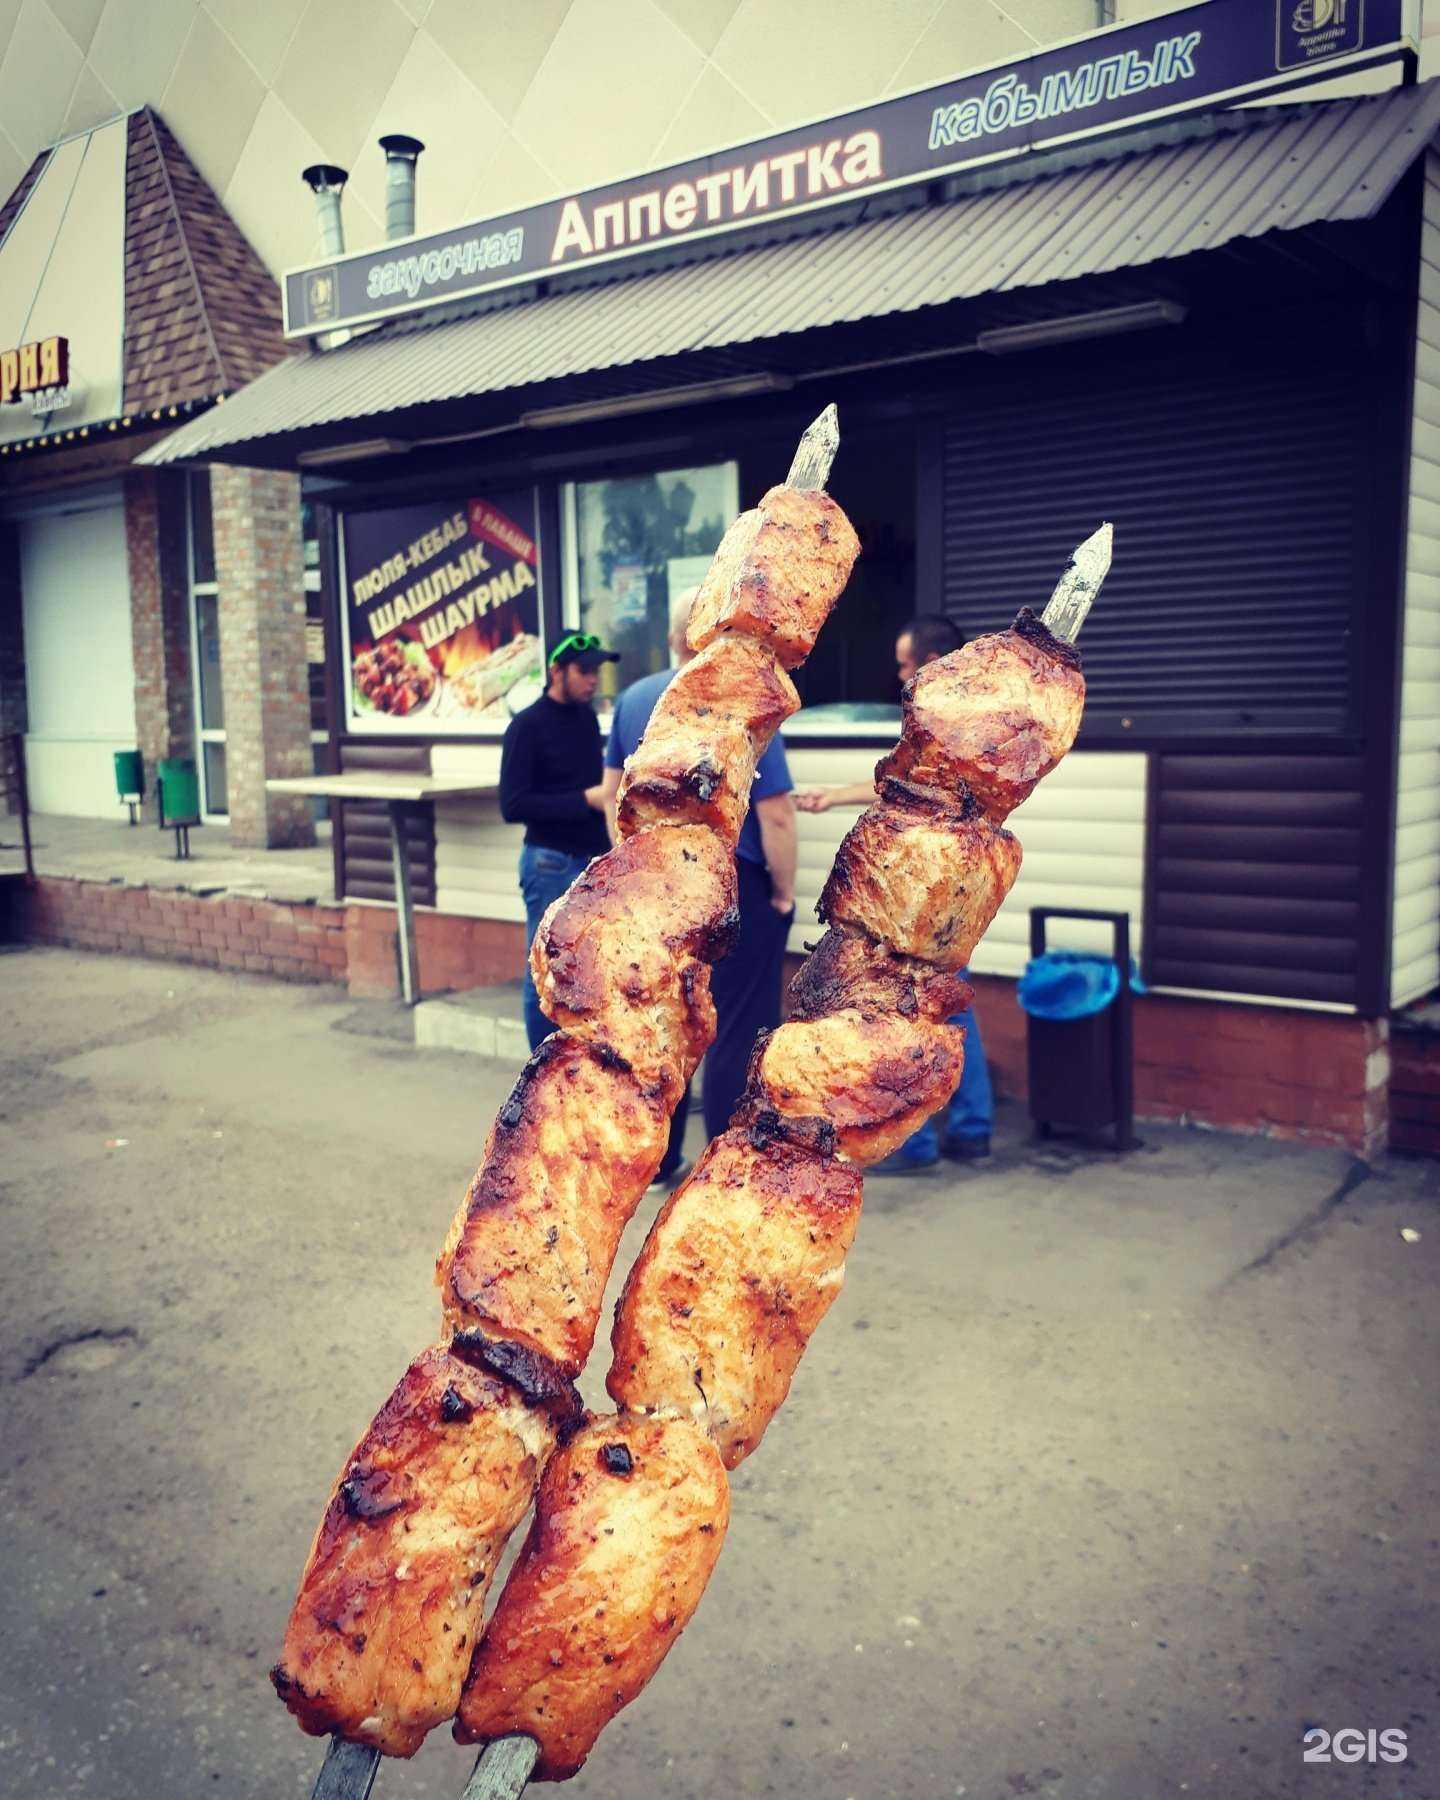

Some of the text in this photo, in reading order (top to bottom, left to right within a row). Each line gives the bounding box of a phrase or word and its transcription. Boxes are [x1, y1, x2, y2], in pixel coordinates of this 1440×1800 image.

[367, 31, 1201, 298] закусочная Аппетитка кабымлык
[352, 512, 468, 606] ЛЮЛЯ-КЕБАБ
[368, 542, 491, 640] ШАШЛЫК
[420, 561, 536, 650] ШАУРМА
